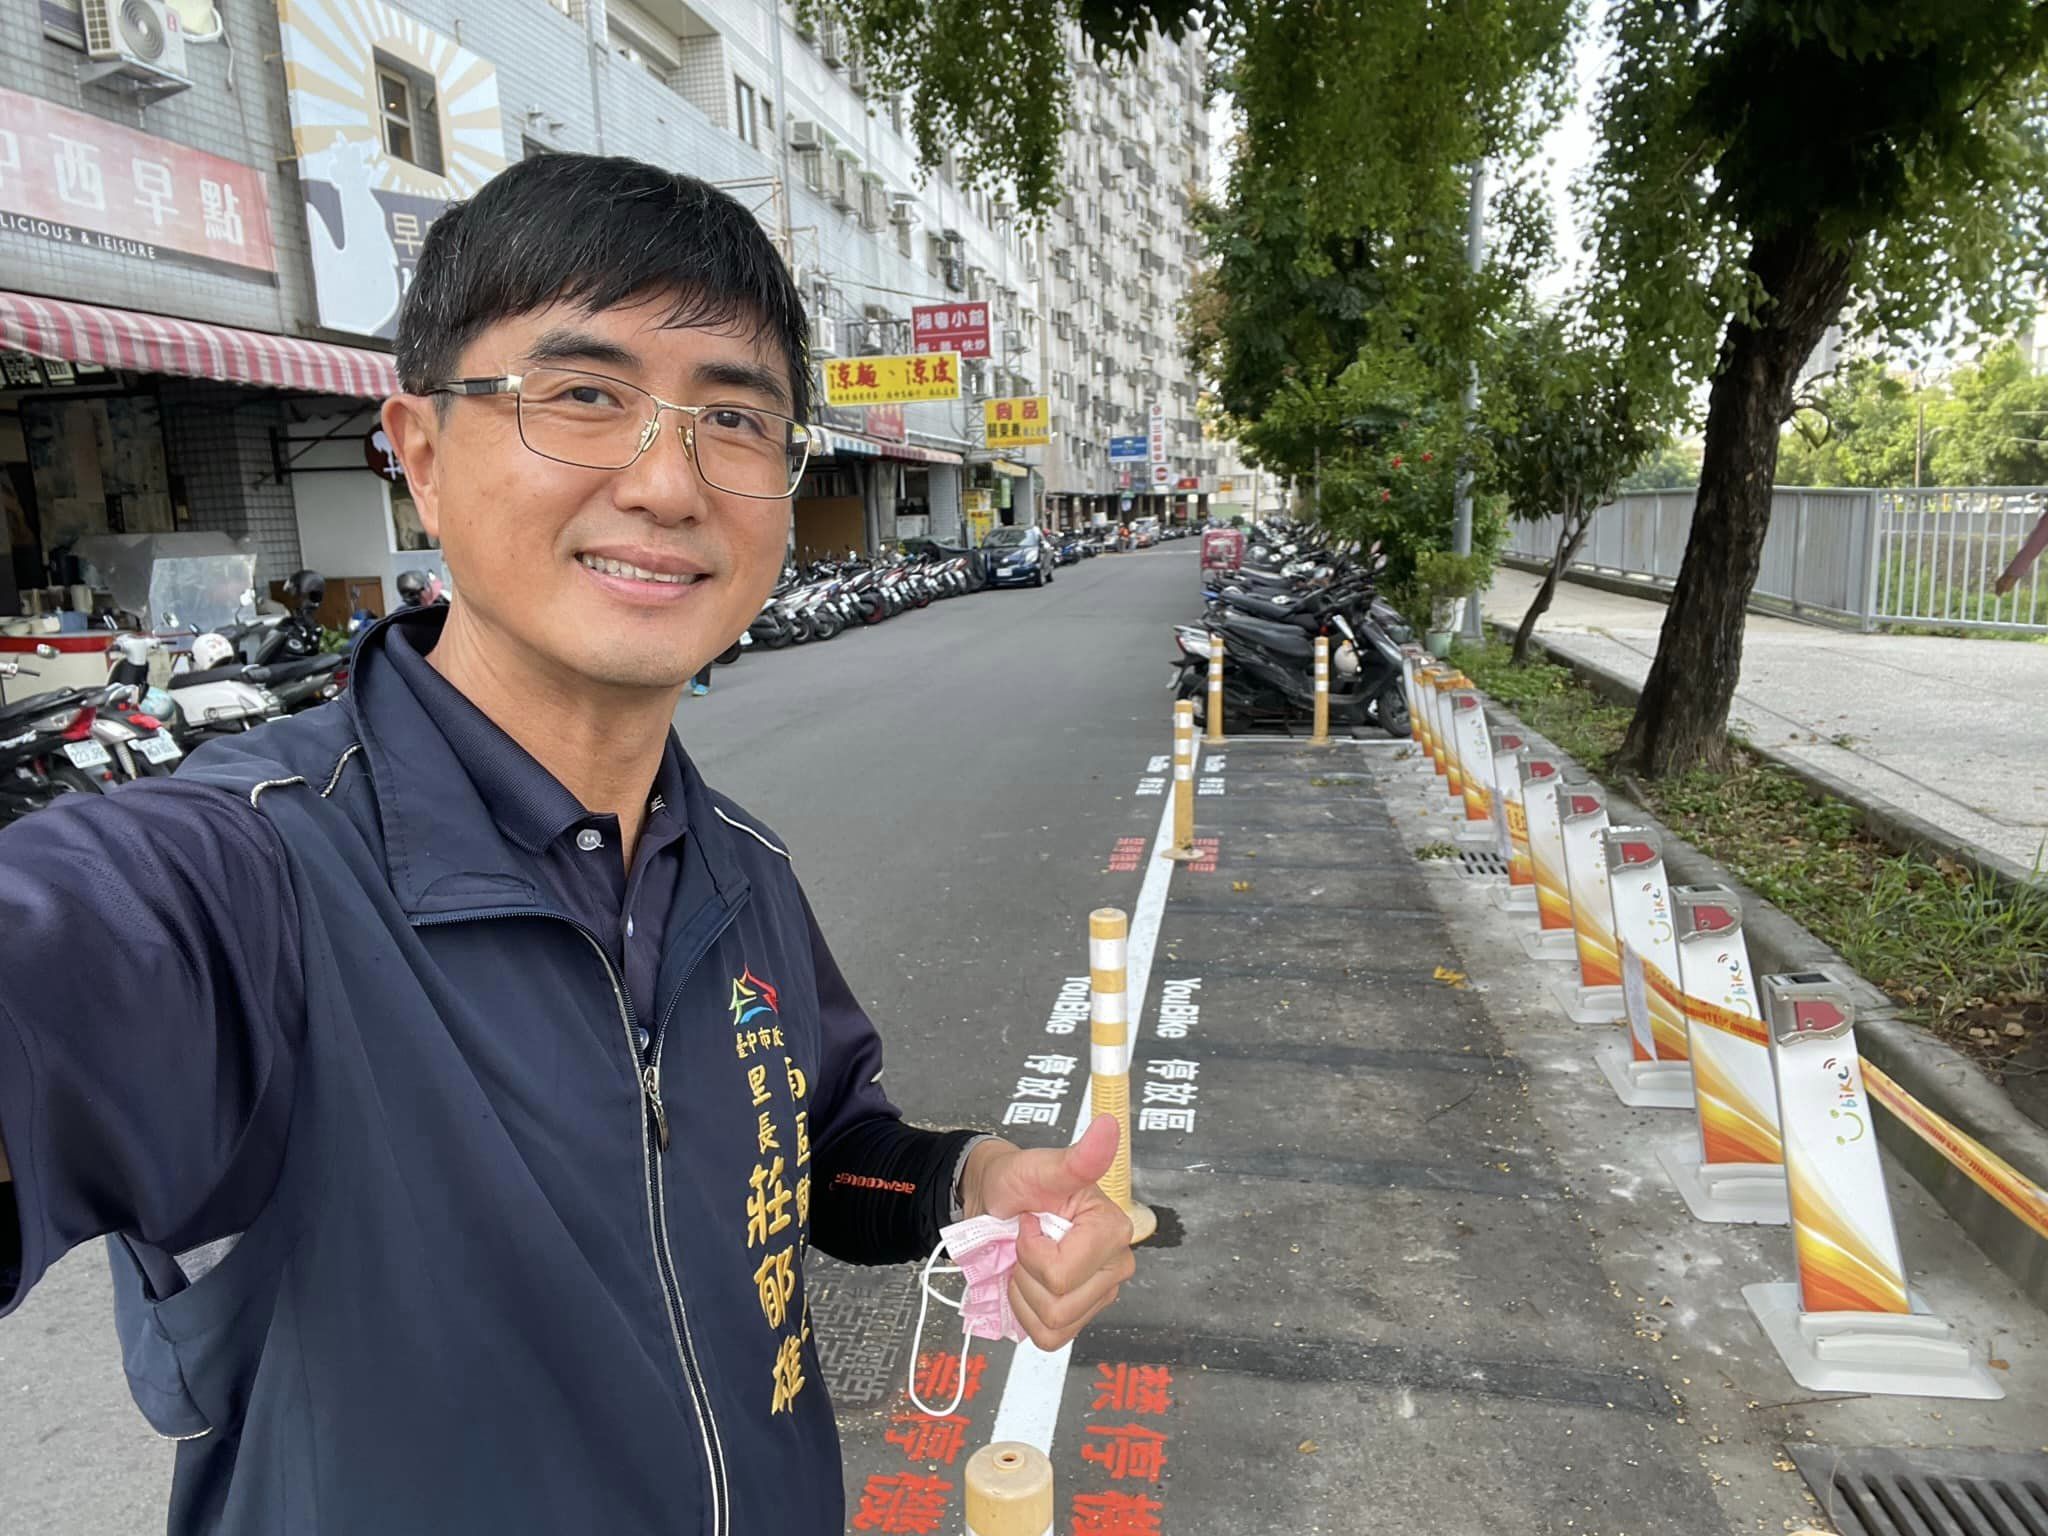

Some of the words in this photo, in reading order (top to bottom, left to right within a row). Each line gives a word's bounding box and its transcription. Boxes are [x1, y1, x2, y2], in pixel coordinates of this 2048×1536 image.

[1045, 976, 1092, 1035] YouBike
[1156, 978, 1202, 1039] YouBike
[1002, 1054, 1078, 1126] 停放區
[1139, 1059, 1201, 1133] 停放區
